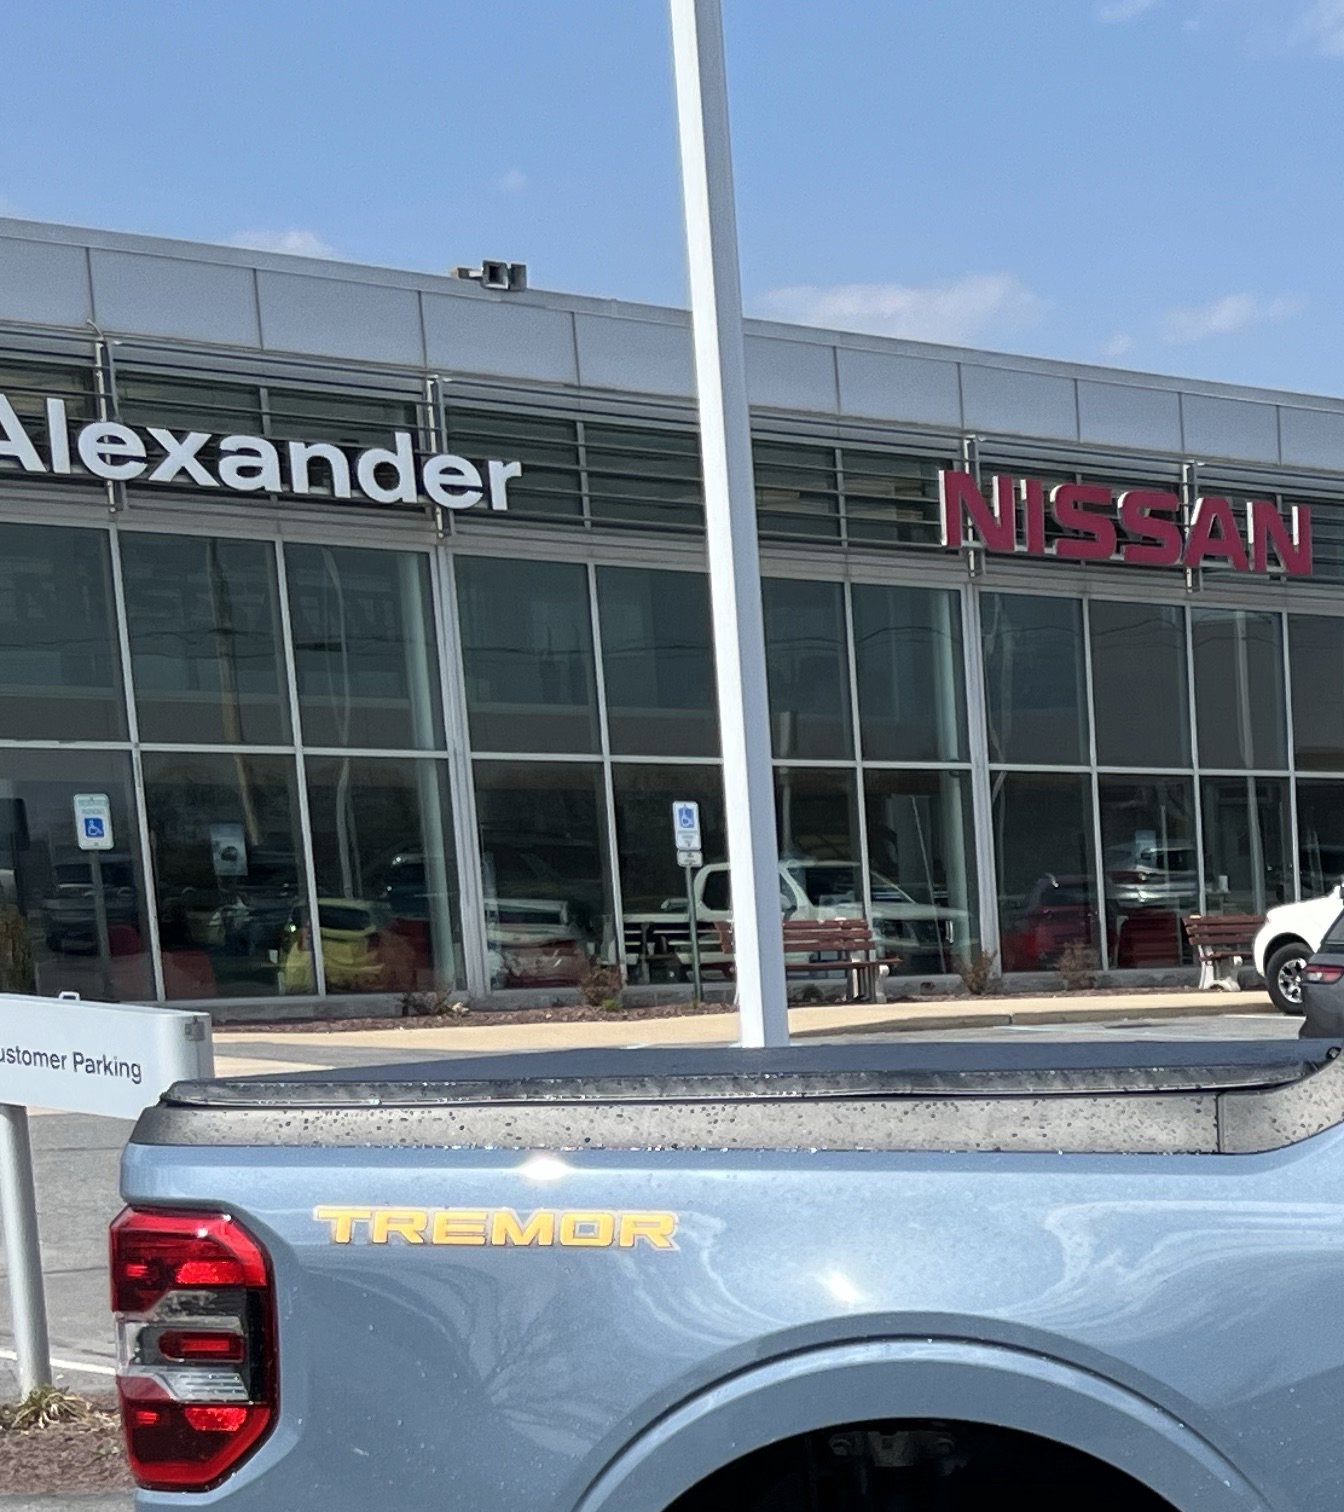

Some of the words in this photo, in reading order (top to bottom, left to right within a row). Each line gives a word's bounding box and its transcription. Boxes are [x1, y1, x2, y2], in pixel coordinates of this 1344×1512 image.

[0, 393, 522, 511] Alexander
[938, 469, 1313, 576] NISSAN
[73, 1051, 142, 1085] Parking
[315, 1206, 679, 1250] TREMOR
